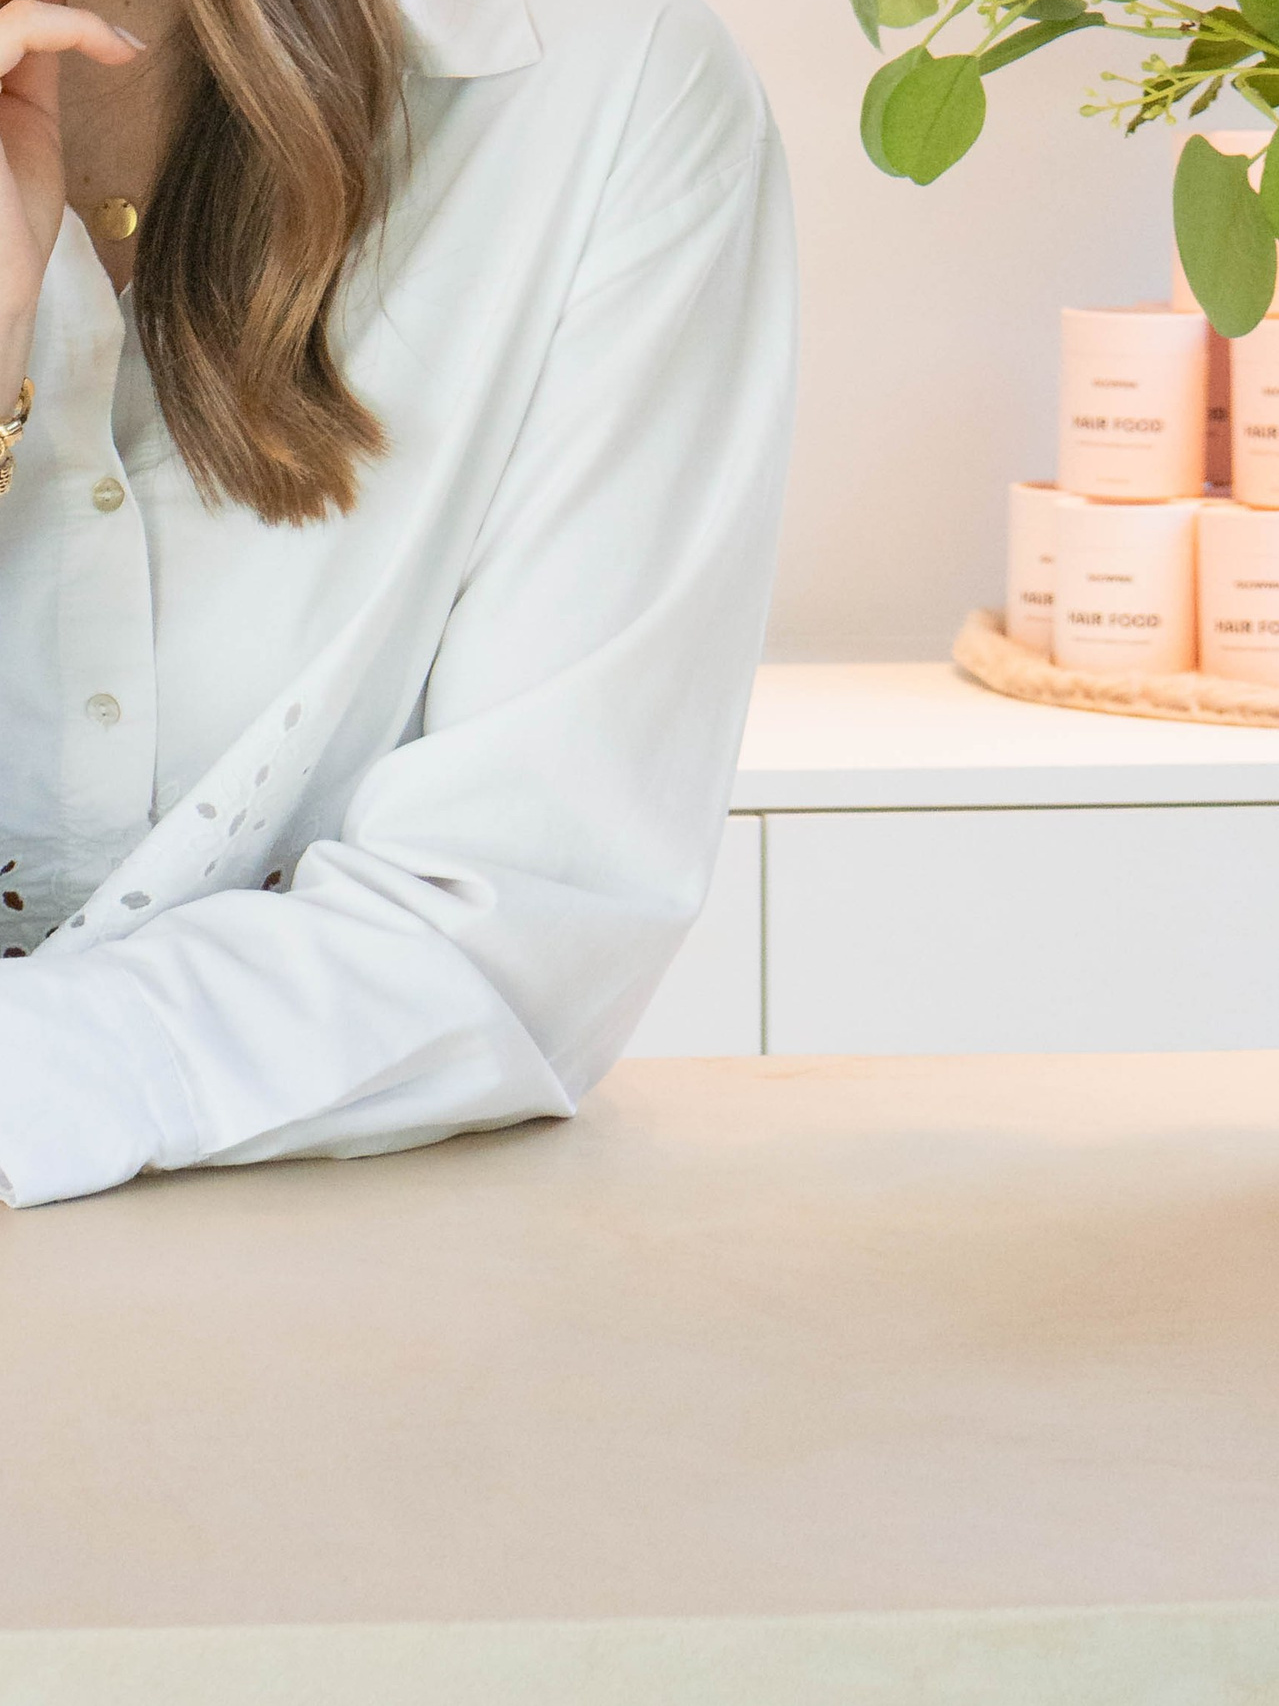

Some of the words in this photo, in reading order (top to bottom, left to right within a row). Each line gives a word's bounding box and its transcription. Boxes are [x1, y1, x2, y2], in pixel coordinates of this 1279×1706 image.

[1073, 414, 1108, 431] HAIR
[1115, 416, 1164, 433] FOOD
[1068, 611, 1102, 627] HAIR
[1109, 612, 1161, 628] FOOD
[1215, 618, 1250, 634] HAIR
